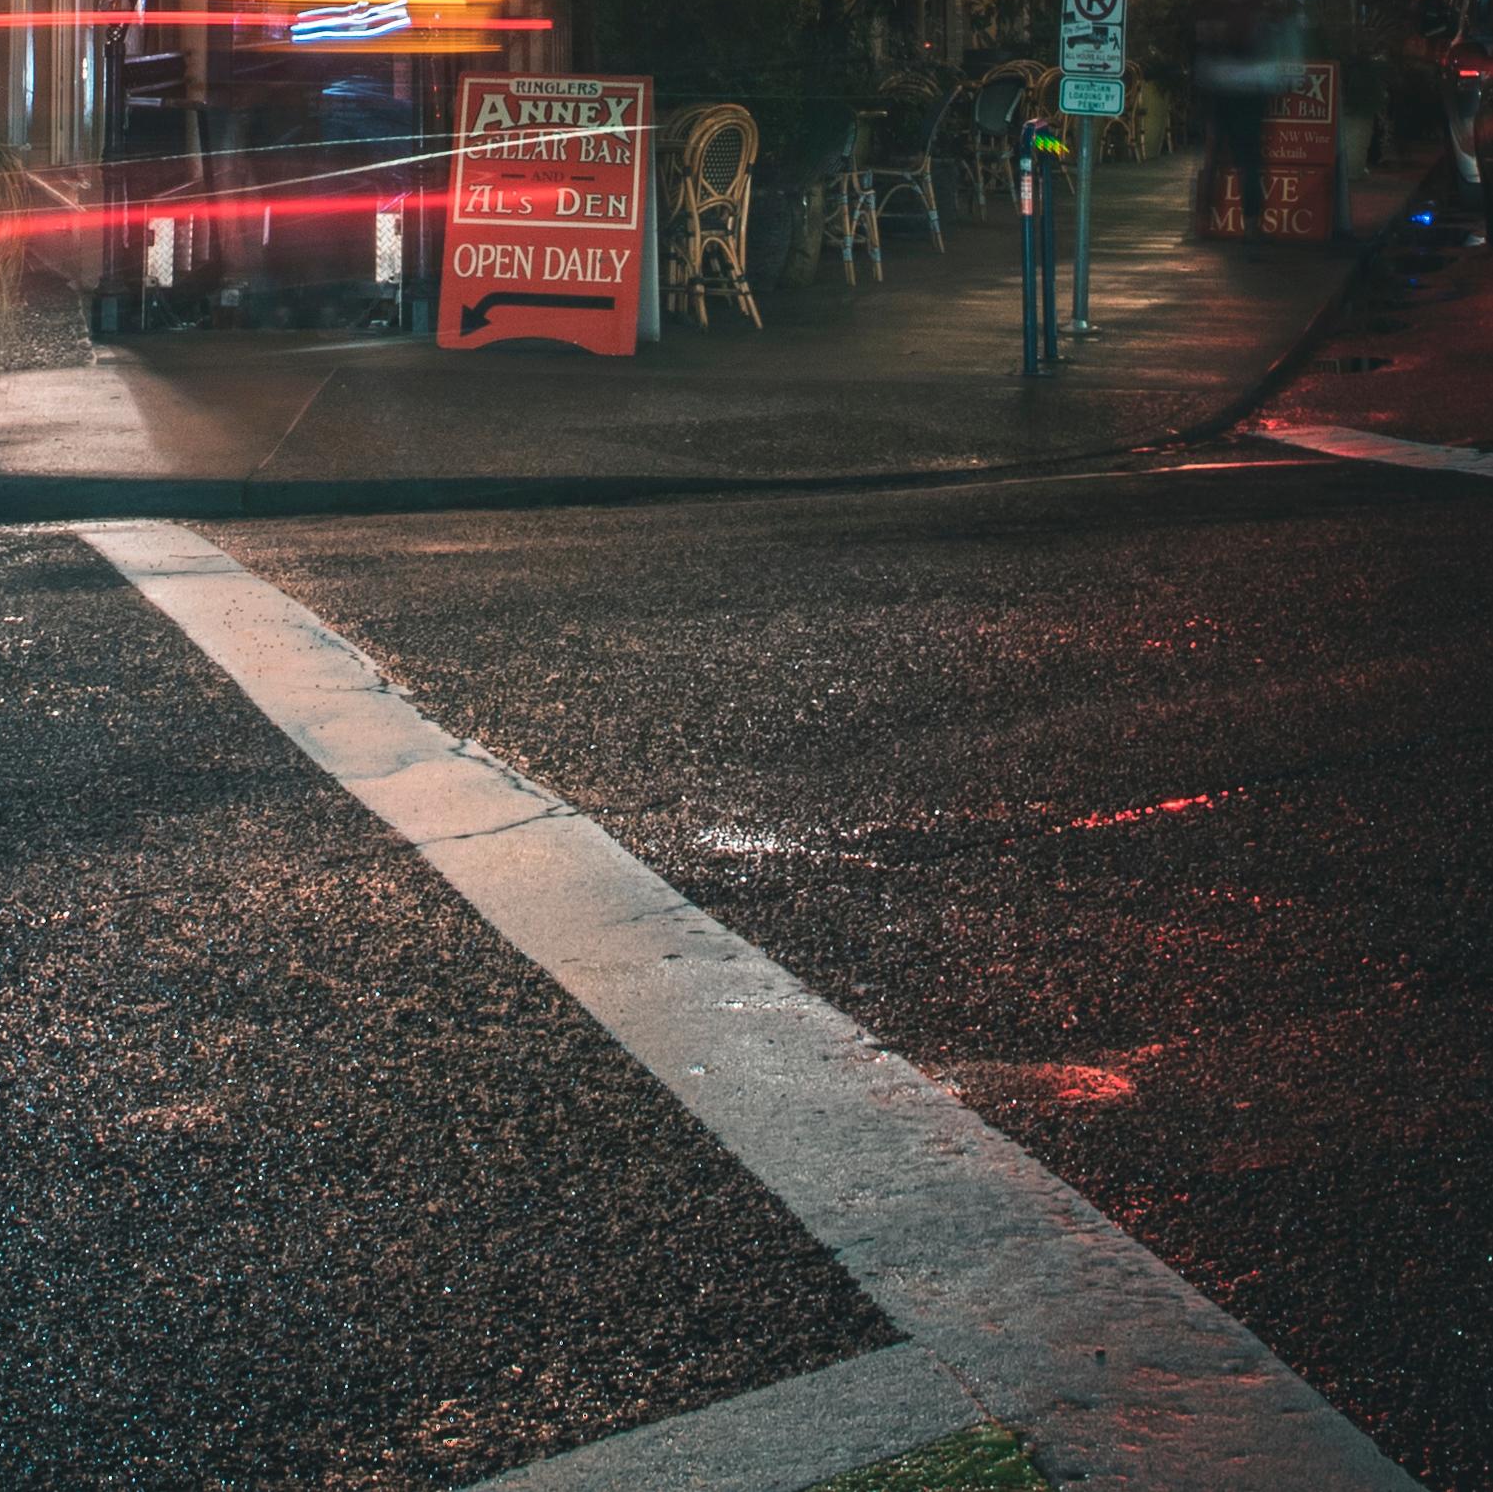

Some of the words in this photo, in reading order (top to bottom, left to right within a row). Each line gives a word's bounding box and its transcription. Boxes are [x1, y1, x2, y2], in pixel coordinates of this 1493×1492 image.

[516, 80, 599, 95] RINGLERS
[470, 94, 634, 144] ANNEX
[467, 130, 567, 161] CELLAR
[580, 135, 631, 165] BAR
[531, 171, 564, 182] AND
[1225, 174, 1299, 203] LVE
[556, 187, 628, 218] DEN
[1210, 206, 1313, 234] MSIC
[453, 243, 535, 280] OPEN
[543, 246, 631, 283] DAILY
